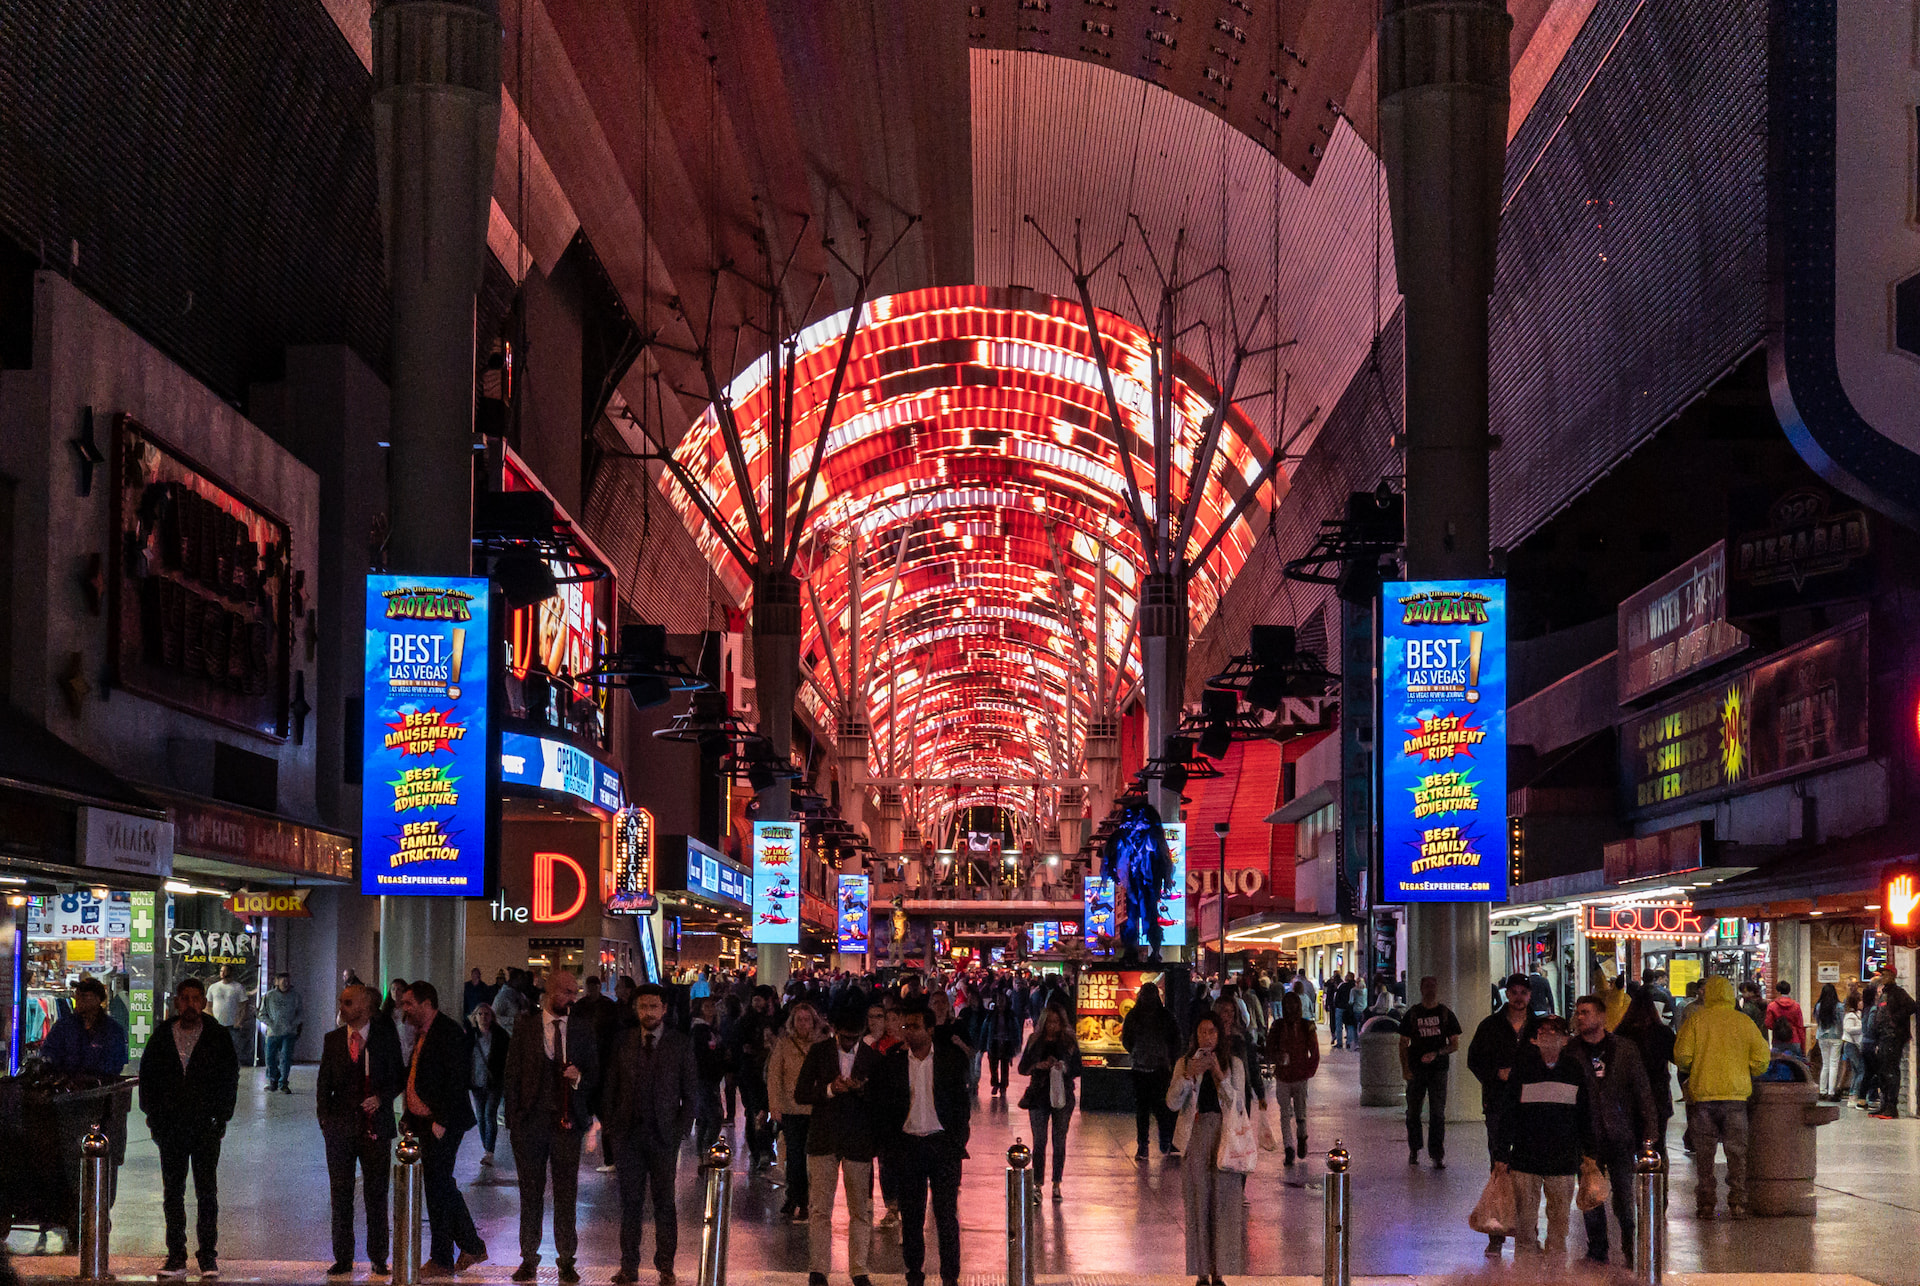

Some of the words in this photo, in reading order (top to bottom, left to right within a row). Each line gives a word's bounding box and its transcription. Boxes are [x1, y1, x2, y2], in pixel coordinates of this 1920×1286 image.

[382, 588, 411, 597] World's
[413, 586, 445, 594] Ultimate
[447, 588, 475, 600] Zipline
[1398, 592, 1427, 603] World's
[1429, 590, 1462, 598] Ultimate
[1463, 591, 1492, 601] Zipline
[389, 634, 444, 664] BEST
[1407, 639, 1461, 669] BEST
[389, 664, 410, 679] LAS
[412, 665, 448, 680] VEGAS
[1407, 670, 1428, 685] LAS
[1430, 670, 1466, 684] VEGAS
[405, 712, 440, 727] BEST
[1423, 716, 1460, 732] BEST
[1638, 696, 1717, 749] SOUVENIRS
[384, 727, 467, 748] AMUSEMENT
[1404, 731, 1486, 753] AMUSEMENT
[409, 739, 436, 754] RIDE
[1428, 744, 1455, 760] RIDE
[1646, 733, 1708, 775] T-SHIRTS
[405, 767, 440, 782] BEST
[1424, 772, 1460, 788] BEST
[394, 781, 452, 798] EXTREME
[1637, 760, 1718, 806] BEVERAGES
[1414, 785, 1472, 804] EXTREME
[394, 794, 459, 812] ADVENTURE
[1414, 798, 1479, 818] ADVENTURE
[403, 821, 439, 835] BEST
[1423, 827, 1460, 842] BEST
[399, 834, 447, 850] FAMILY
[1420, 839, 1468, 855] FAMILY
[390, 846, 460, 868] ATTRACTION
[627, 817, 638, 892] AMERICAN
[1411, 853, 1480, 874] ATTRACTION
[490, 887, 528, 923] the
[532, 852, 588, 923] D
[1186, 867, 1263, 895] SINO
[131, 897, 153, 906] ROLLS
[234, 896, 302, 912] LIQUOR
[1491, 918, 1520, 926] ELRY
[1590, 905, 1701, 932] LIQUOR
[62, 925, 99, 935] 3-PACK
[131, 942, 152, 952] EDIBLES
[172, 931, 257, 960] SAFARI
[1527, 943, 1545, 953] OEN
[184, 955, 206, 963] LAS
[209, 956, 246, 964] VEGAS
[1078, 974, 1119, 985] MAN'S
[1077, 984, 1118, 999] BEST
[130, 1002, 152, 1012] ROLLS
[1077, 999, 1118, 1010] FRIEND.
